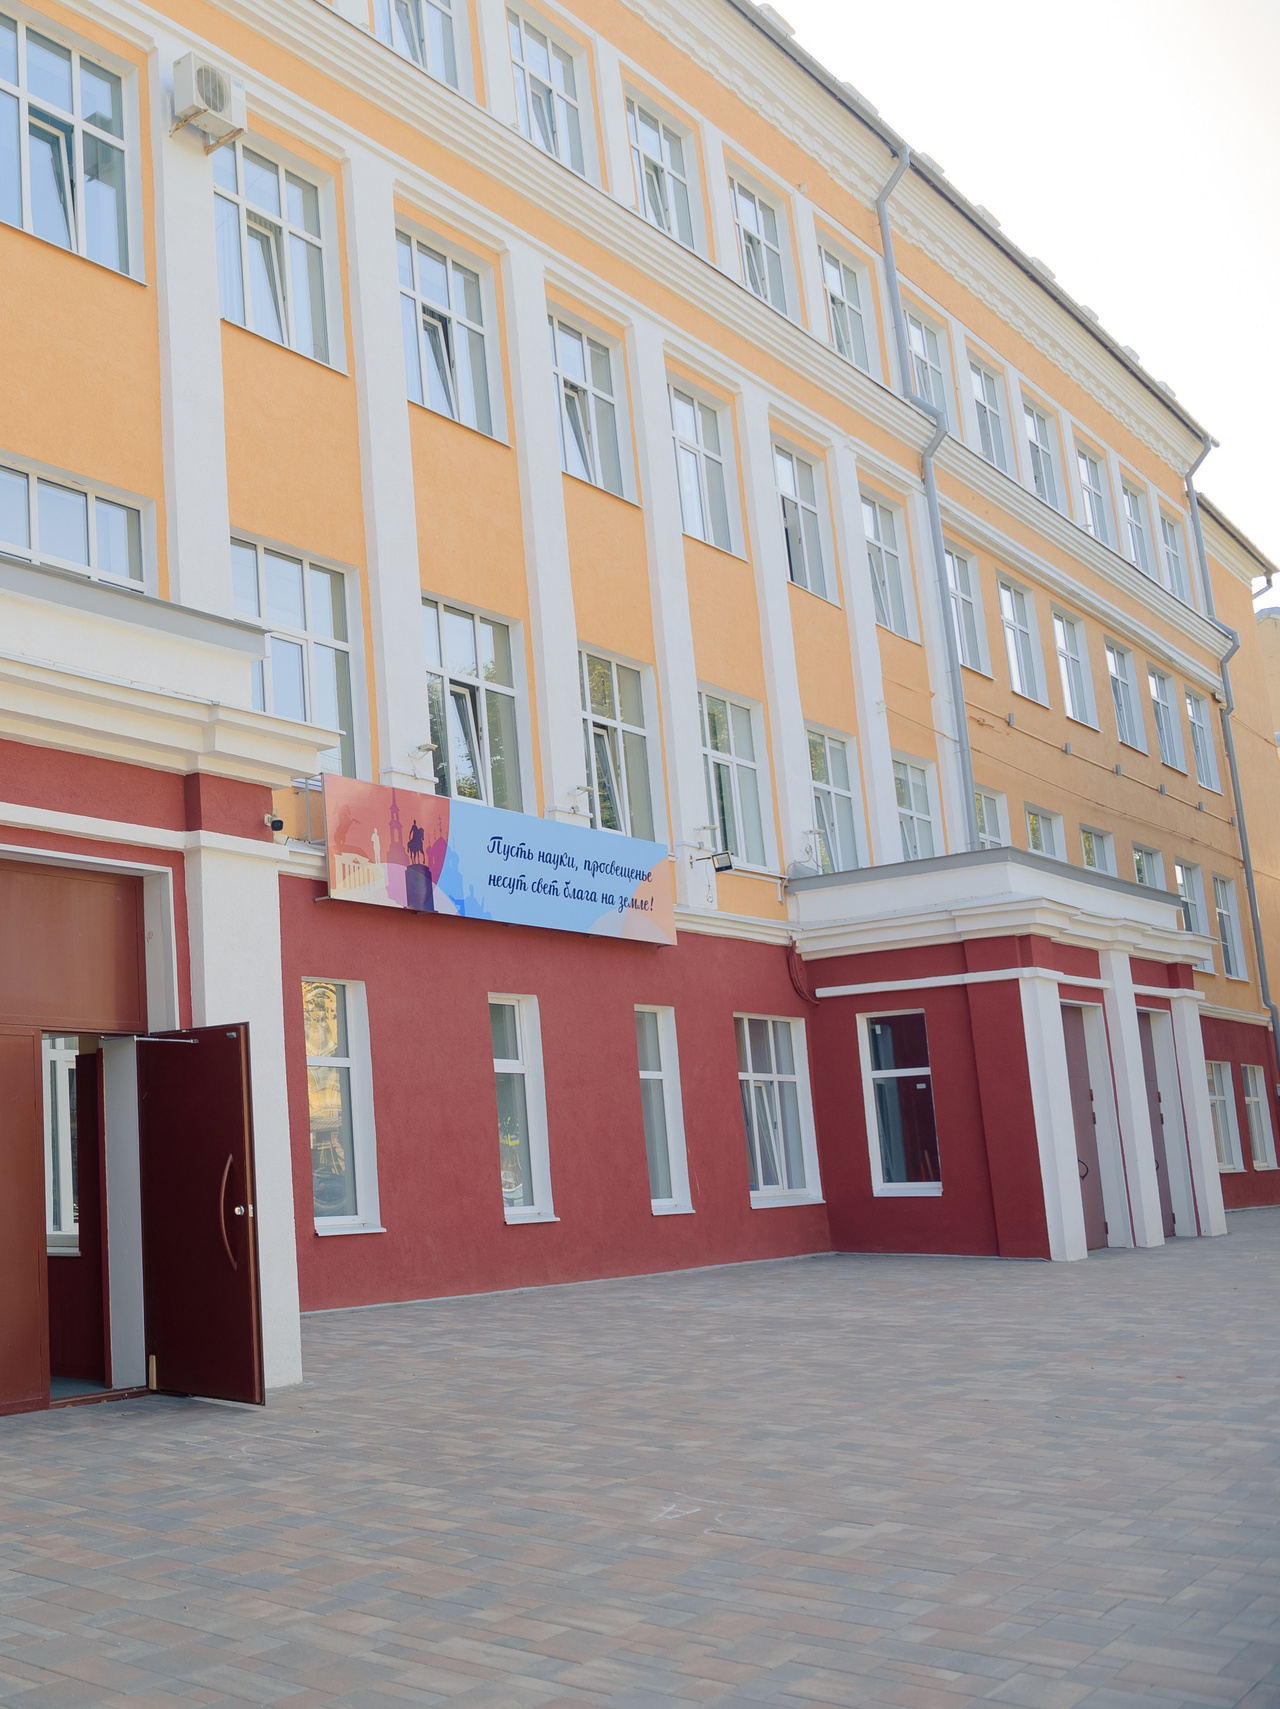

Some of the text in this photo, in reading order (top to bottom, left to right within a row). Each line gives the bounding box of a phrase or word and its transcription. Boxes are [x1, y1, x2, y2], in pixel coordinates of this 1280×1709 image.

[487, 836, 653, 883] Пусть науки, просвещенье
[488, 874, 654, 914] несут свет блага на земле!
